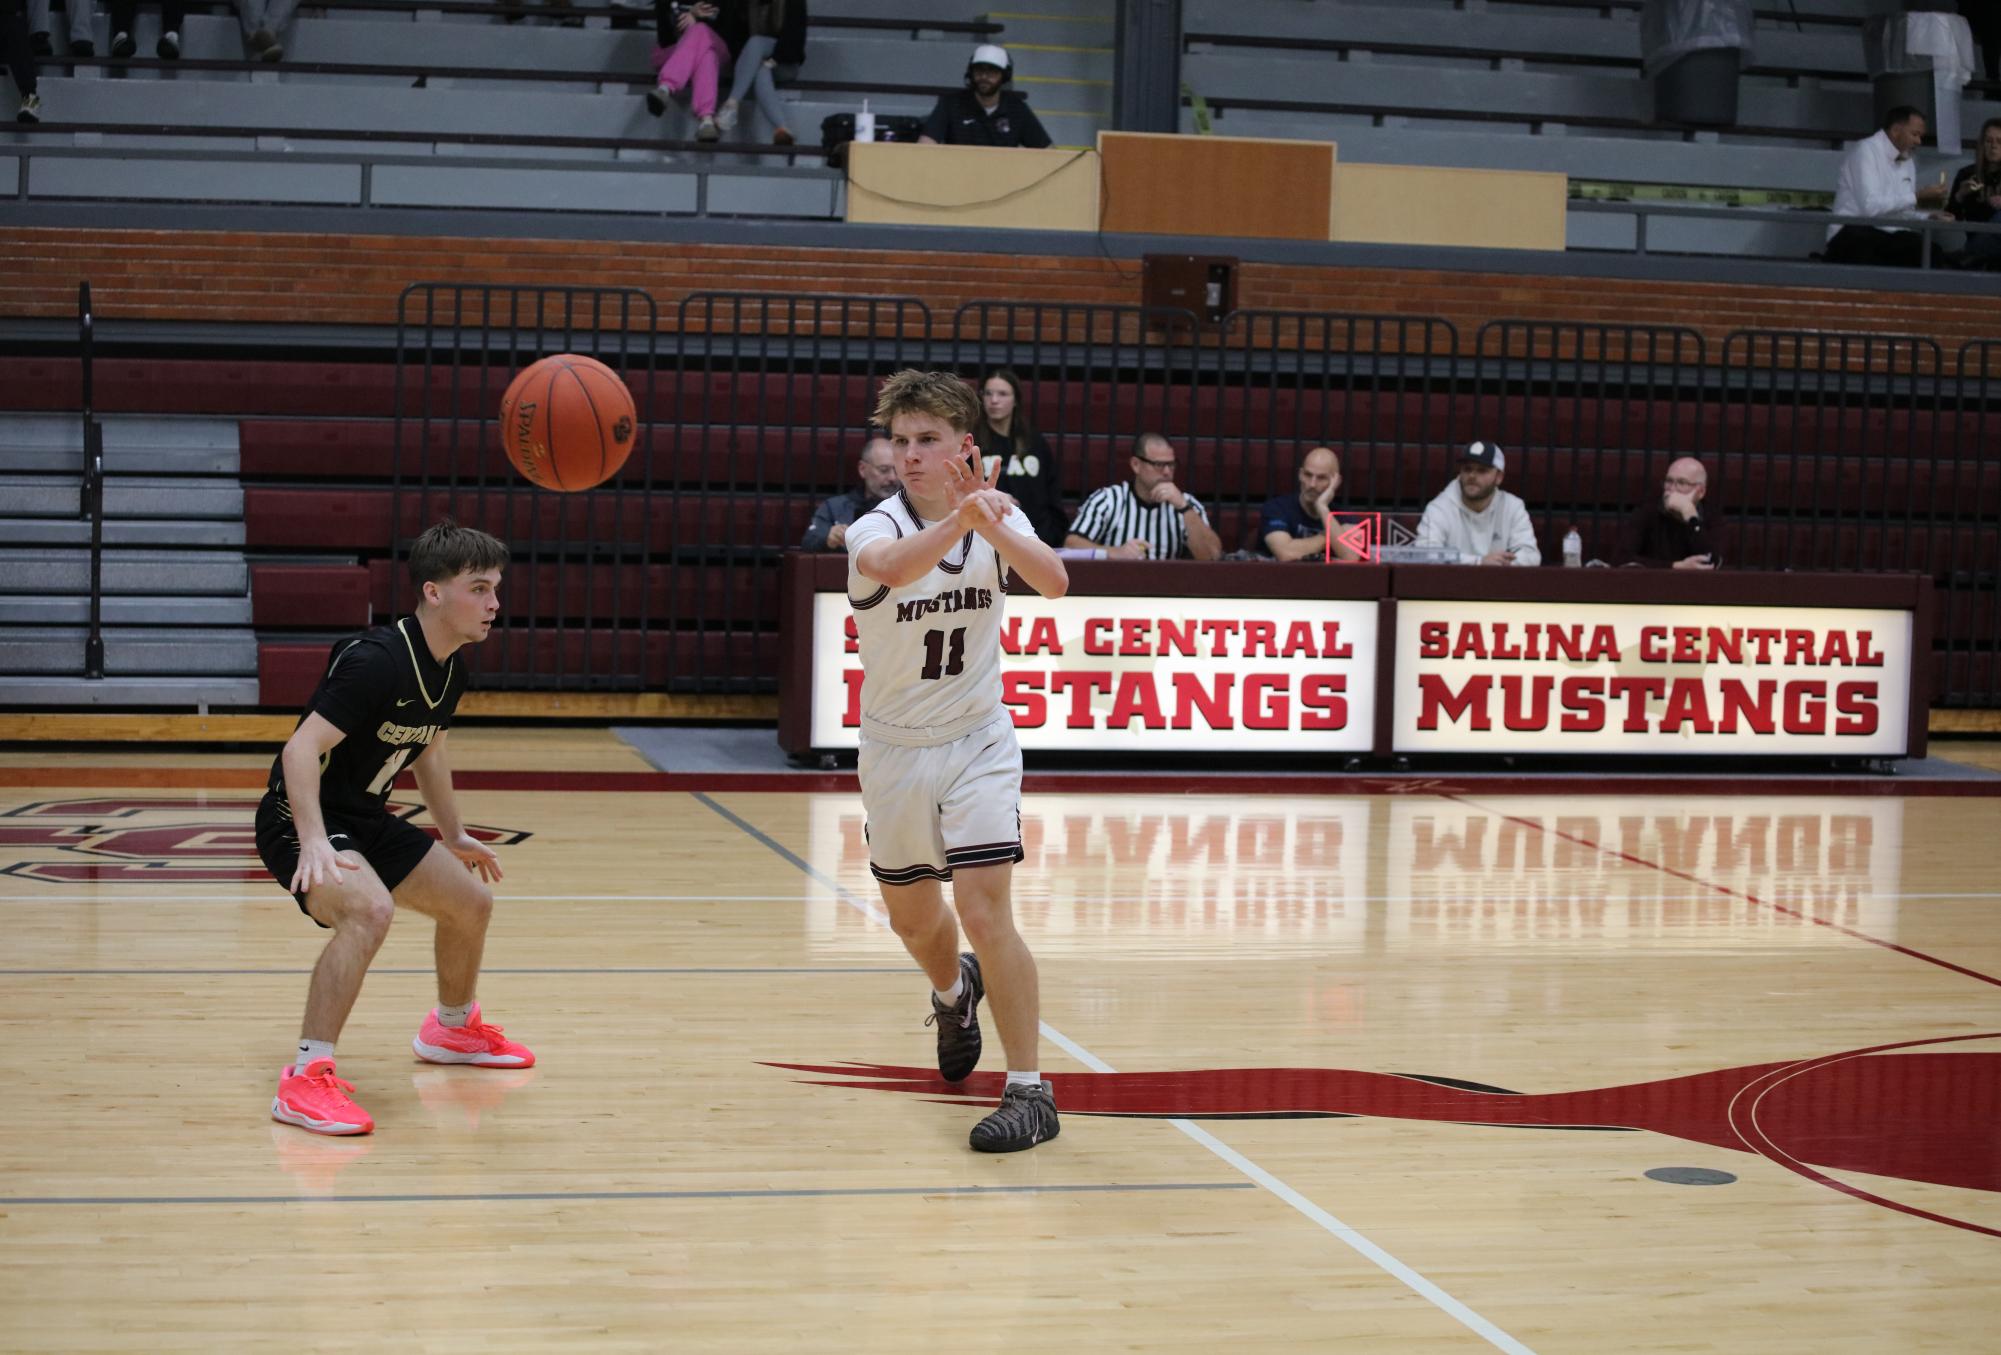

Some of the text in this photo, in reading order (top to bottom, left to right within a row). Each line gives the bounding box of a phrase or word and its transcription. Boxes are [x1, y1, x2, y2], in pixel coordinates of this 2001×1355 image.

[896, 587, 992, 623] MUSTANGS
[921, 627, 967, 680] 11
[1084, 617, 1353, 659] CENTRAL
[1419, 621, 1885, 667] SALINA CENTRAL
[1417, 674, 1879, 736] MUSTANGS
